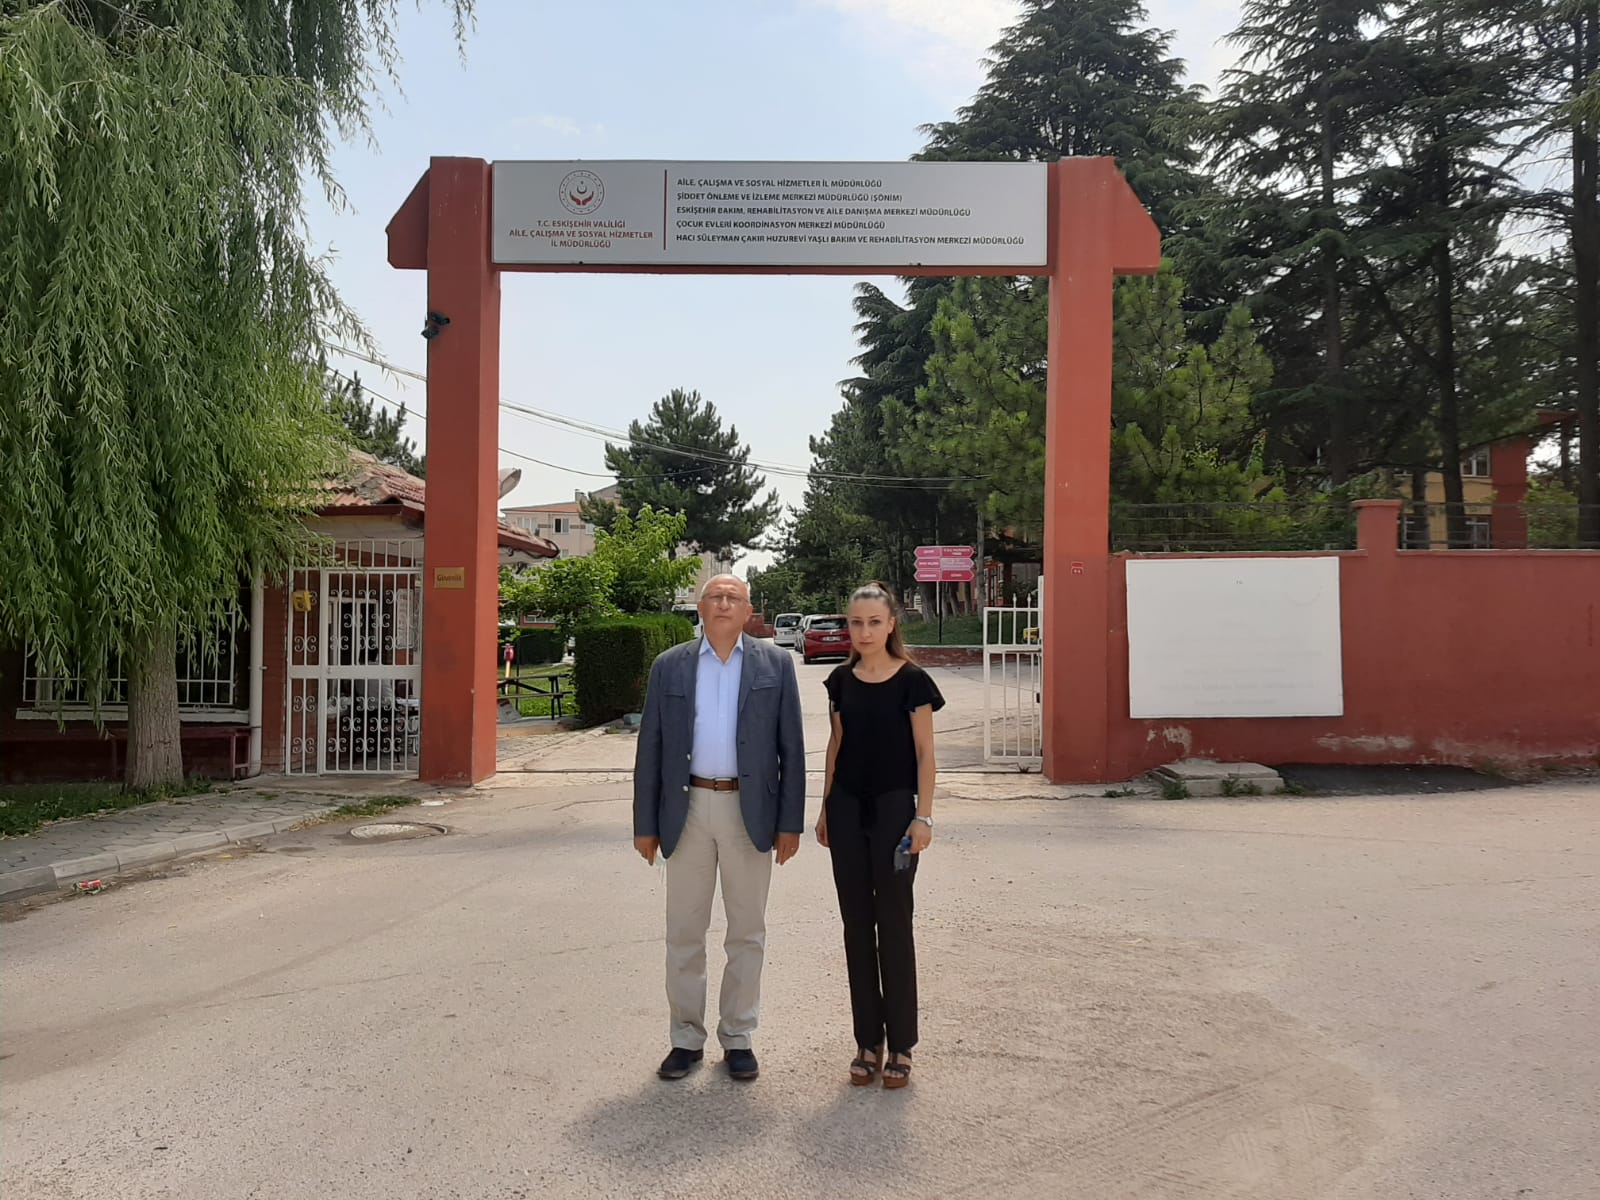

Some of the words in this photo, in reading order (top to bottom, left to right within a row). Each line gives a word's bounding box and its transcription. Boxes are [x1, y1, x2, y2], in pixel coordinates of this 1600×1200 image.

[777, 179, 820, 187] HİZMETLER
[823, 179, 829, 187] İL
[677, 206, 716, 214] ESKİŞEHİR
[552, 220, 591, 229] ESKİŞEHİR
[593, 220, 625, 228] VALİLİĞİ
[834, 221, 885, 229] MÜDÜRLÜĞÜ
[530, 230, 564, 238] ÇALIŞMA
[560, 240, 611, 248] MÜDÜRLÜĞÜ
[741, 235, 764, 243] ÇAKIR
[869, 236, 935, 244] REHABİLİTASYON
[973, 237, 1024, 245] MÜDÜRLÜĞÜ
